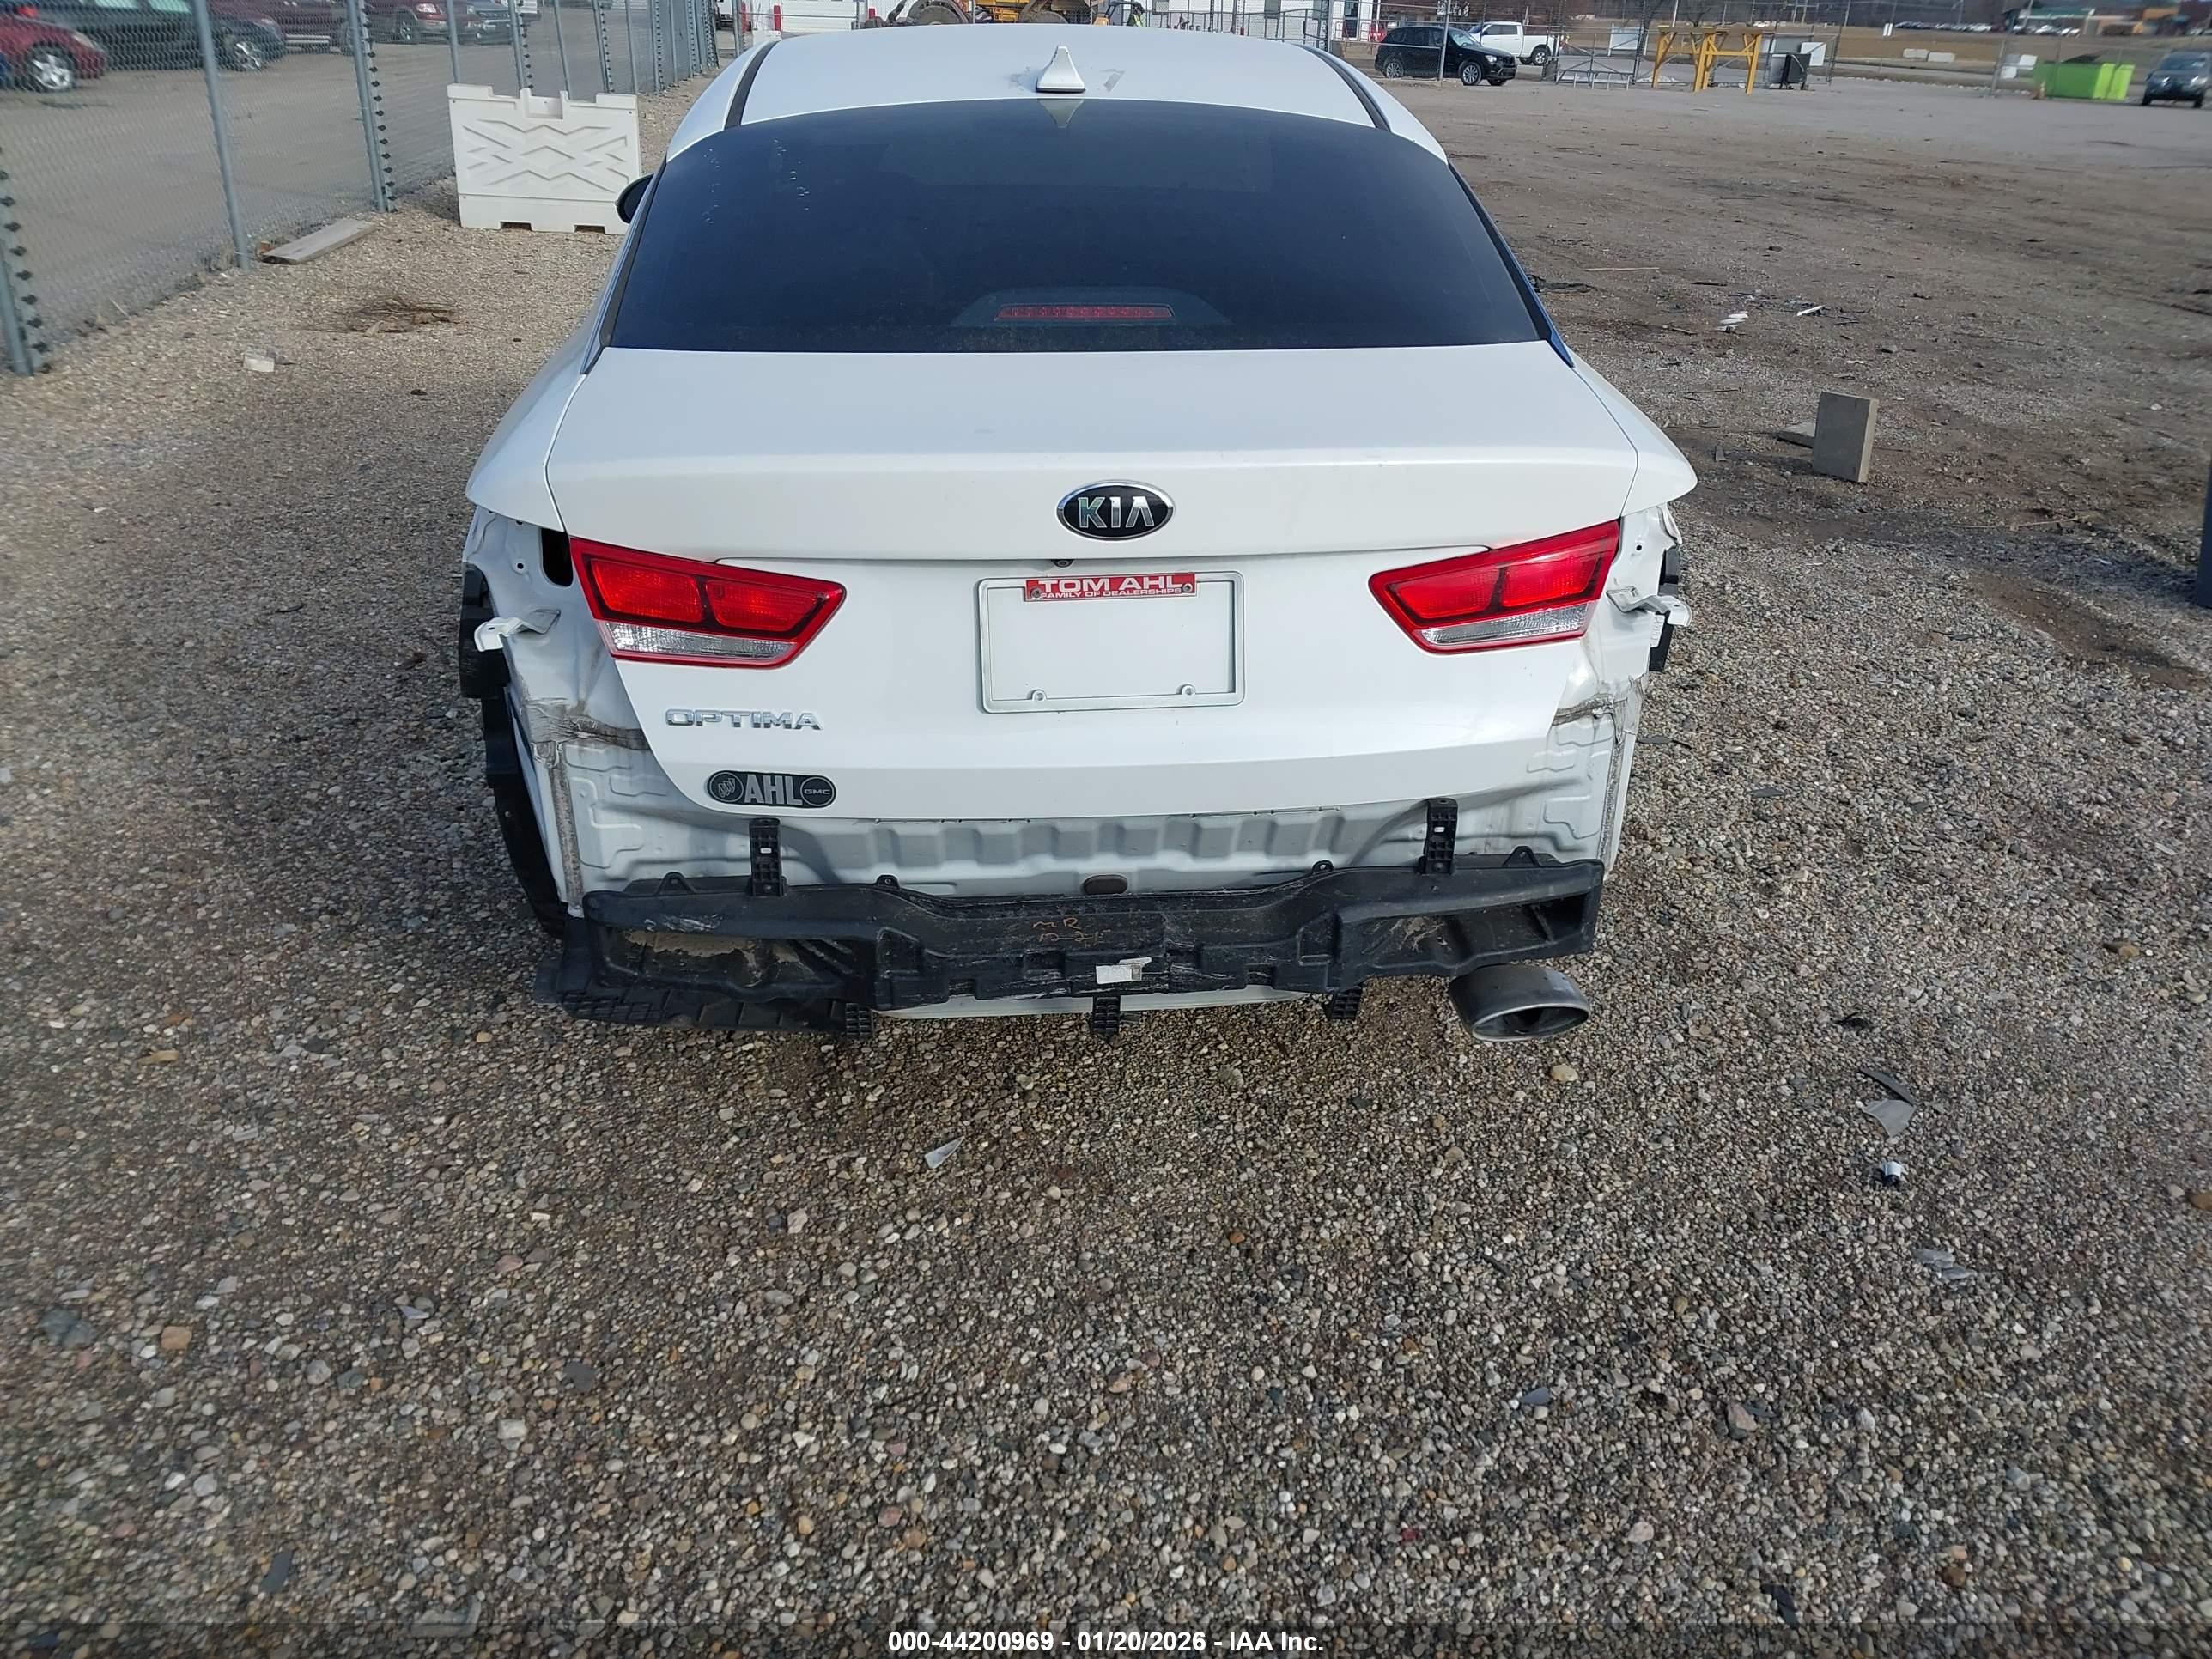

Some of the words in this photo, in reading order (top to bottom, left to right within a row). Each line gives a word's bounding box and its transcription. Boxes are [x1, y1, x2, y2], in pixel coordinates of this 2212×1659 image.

[1078, 496, 1155, 528] KIA
[1038, 578, 1109, 593] TOM
[1119, 576, 1182, 590] AHL
[1103, 587, 1182, 597] DEALERSHIPS
[665, 709, 822, 730] OPTIMA
[744, 774, 803, 805] AHL
